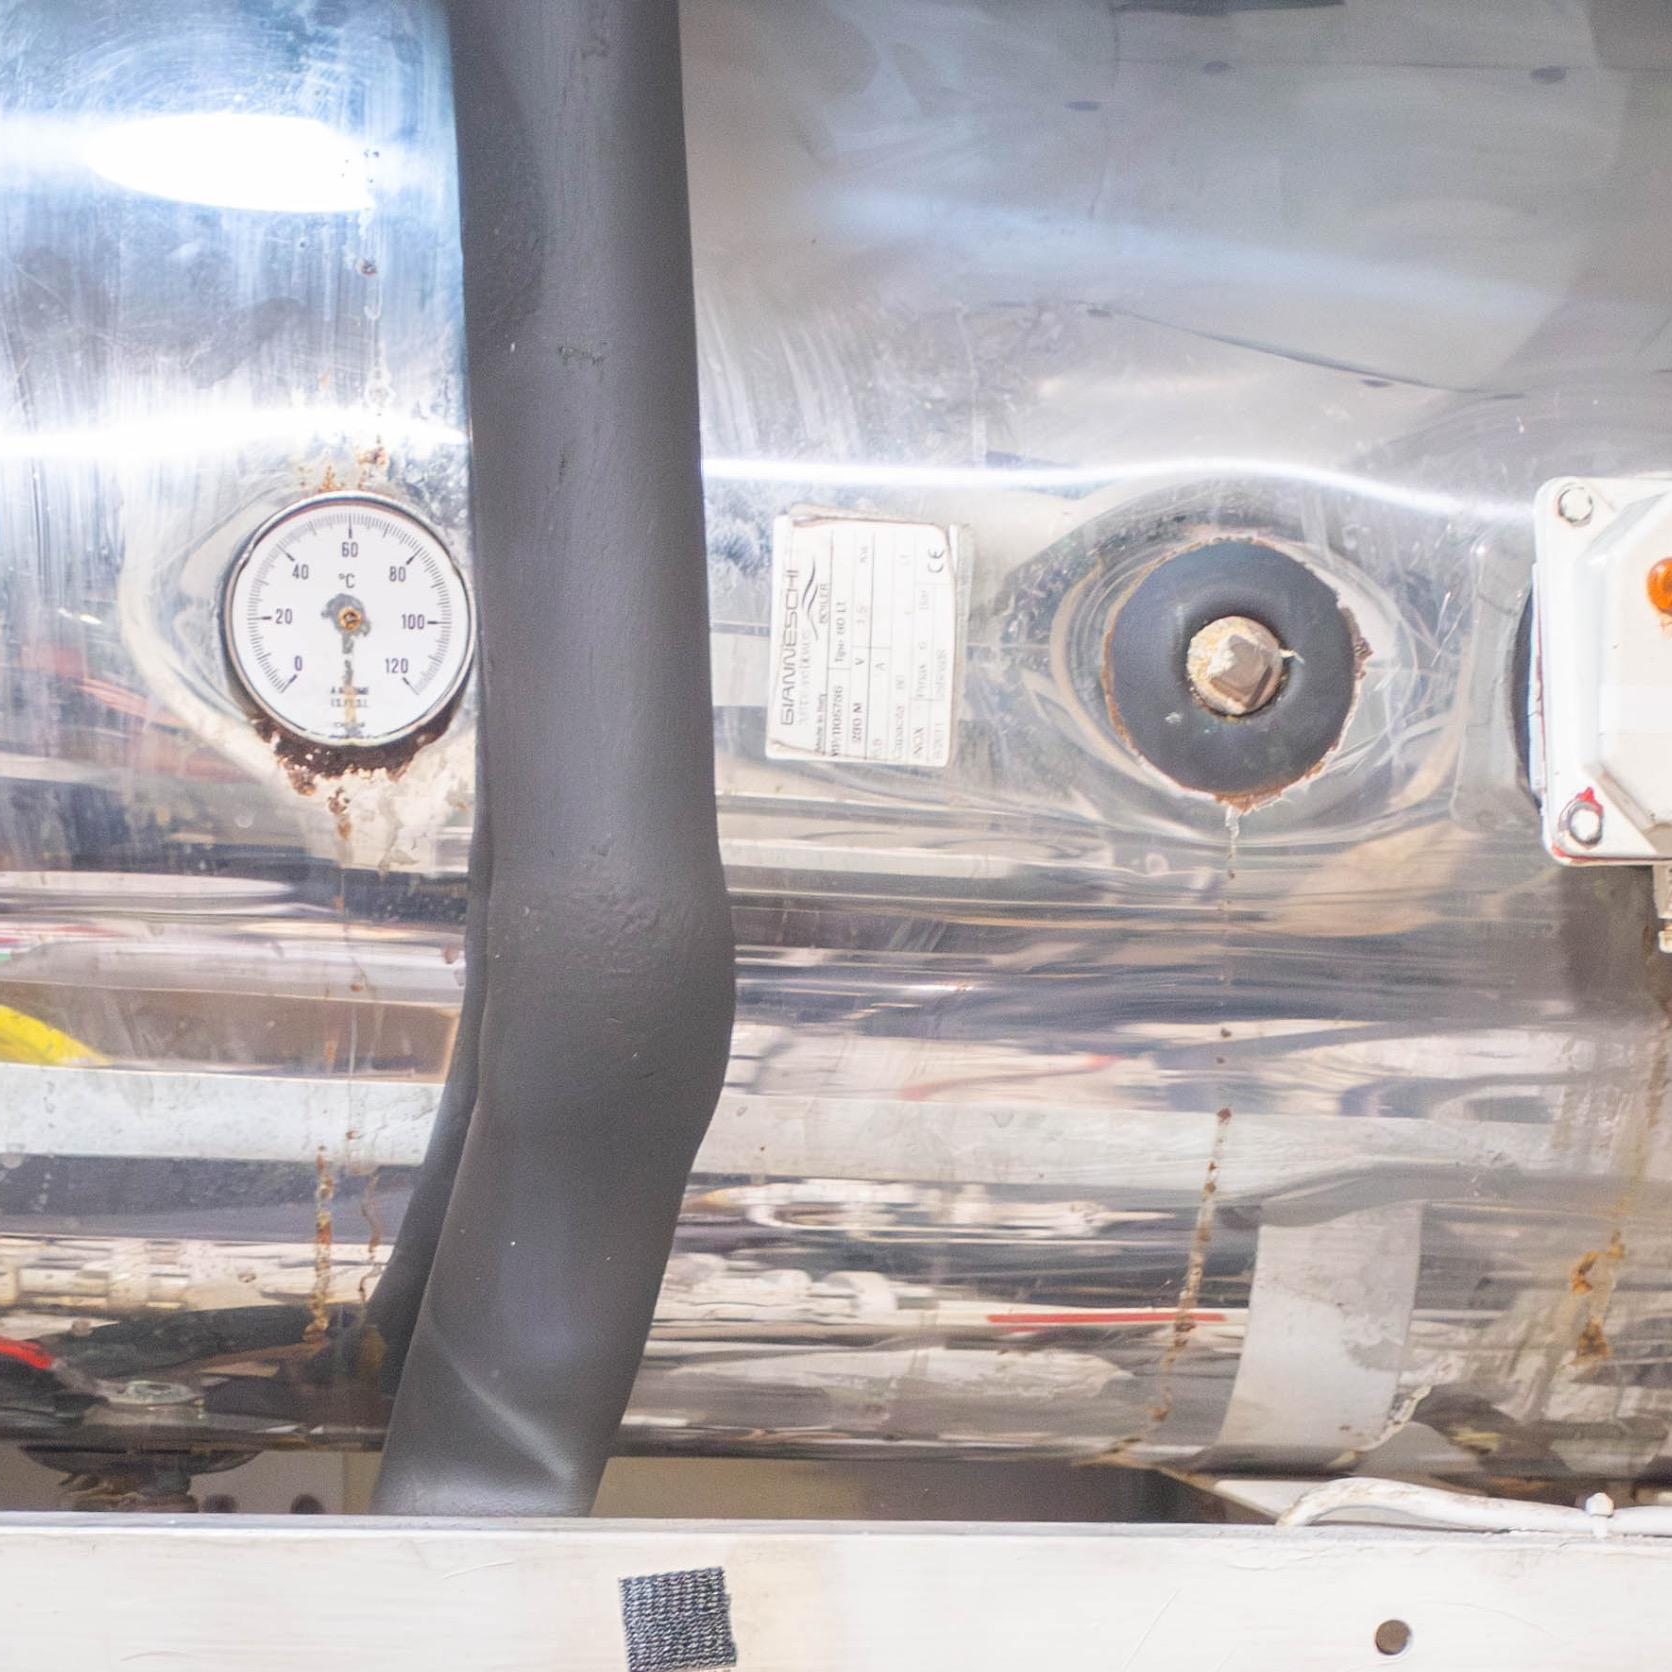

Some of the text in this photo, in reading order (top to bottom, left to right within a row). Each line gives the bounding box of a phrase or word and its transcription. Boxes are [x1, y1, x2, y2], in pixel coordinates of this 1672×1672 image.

[341, 541, 359, 558] 60
[291, 564, 309, 580] 40
[389, 566, 406, 582] 80
[338, 573, 356, 589] °C
[276, 608, 293, 624] 20
[401, 613, 425, 630] 100
[780, 569, 799, 726] GIANNESCHI
[294, 655, 303, 672] 0
[384, 657, 409, 674] 120
